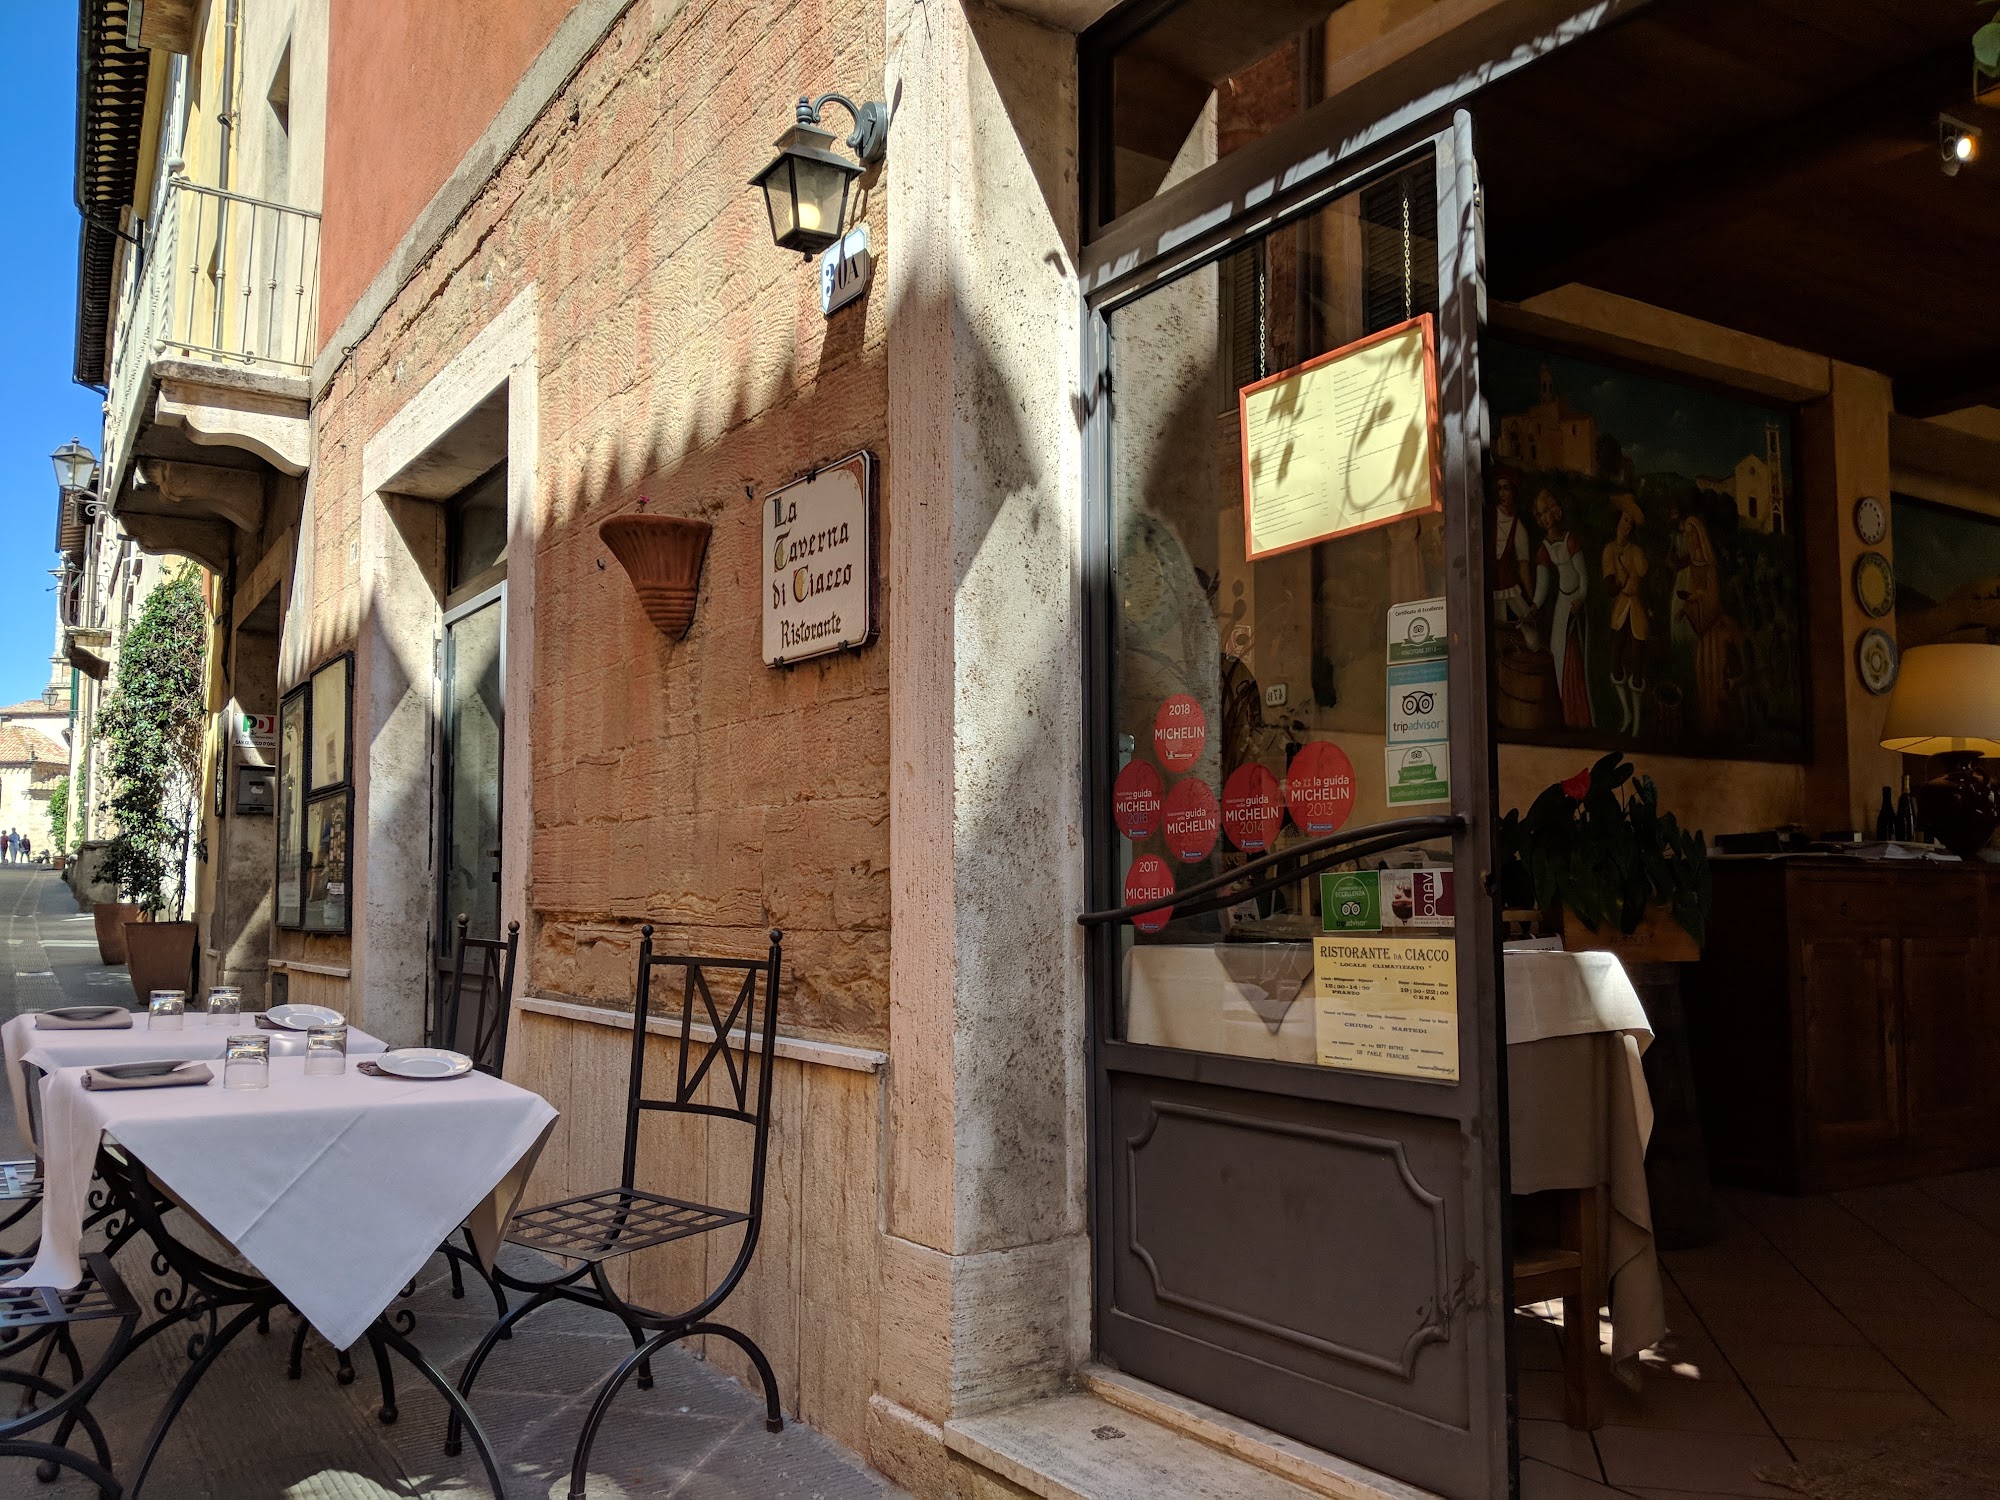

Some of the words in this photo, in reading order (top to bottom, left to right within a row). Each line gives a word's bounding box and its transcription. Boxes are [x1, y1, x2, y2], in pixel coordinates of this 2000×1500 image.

[826, 253, 859, 298] 30A
[772, 496, 797, 529] La
[773, 521, 849, 572] Taverna
[772, 579, 786, 610] di
[793, 563, 852, 603] Ciacco
[780, 610, 841, 651] Ristorante
[1168, 703, 1191, 716] 2018
[243, 715, 274, 733] PD
[1393, 719, 1441, 734] tripadvisor
[1154, 726, 1205, 741] MICHELIN
[1313, 776, 1322, 786] la
[1323, 775, 1350, 788] guida
[1132, 789, 1152, 800] guida
[1246, 794, 1269, 807] guida
[1291, 787, 1350, 802] MICHELIN
[1116, 800, 1160, 813] MICHELIN
[1185, 807, 1206, 820] guida
[1225, 806, 1279, 822] MICHELIN
[1306, 802, 1334, 817] 2013
[1128, 812, 1148, 824] 2016
[1167, 818, 1216, 835] MICHELIN
[1239, 820, 1264, 834] 2014
[1139, 861, 1159, 873] 2017
[1126, 887, 1174, 900] MICHELIN
[1335, 890, 1366, 898] ECCELLENZA
[1320, 946, 1391, 959] RISTORANTE
[1405, 948, 1449, 962] CIACCO
